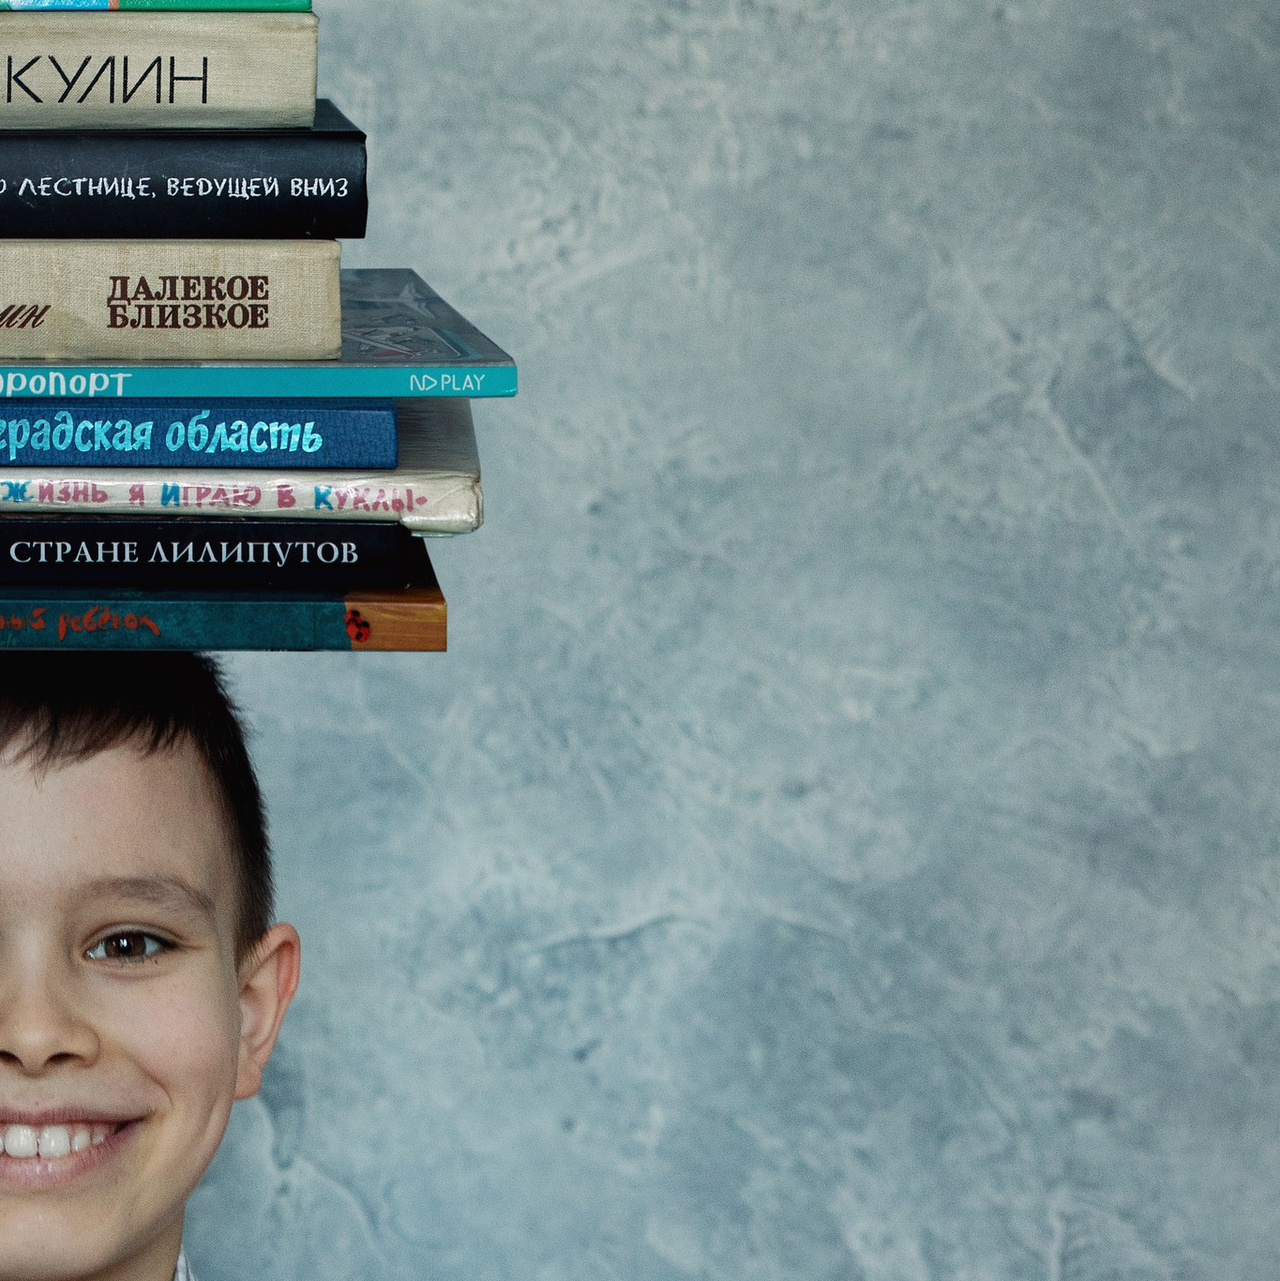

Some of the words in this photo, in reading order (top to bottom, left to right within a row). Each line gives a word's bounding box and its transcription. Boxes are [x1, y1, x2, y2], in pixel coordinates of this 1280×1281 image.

[18, 176, 157, 200] ЛЕСТНИЦЕ,
[167, 176, 280, 200] ВЕДУЩЕЙ
[290, 178, 348, 198] ВНИЗ
[107, 275, 269, 304] ДАЛЕКОЕ
[107, 303, 269, 329] БЛИЗКОЕ
[165, 410, 324, 455] область
[1, 477, 109, 504] ЖИЗНЬ
[129, 480, 146, 506] Я
[160, 481, 262, 507] ИГРАЮ
[276, 481, 296, 508] В
[313, 484, 414, 513] КУКЛЫ
[10, 541, 139, 564] СТРАНЕ
[148, 541, 360, 568] ЛИЛИПУТОВ
